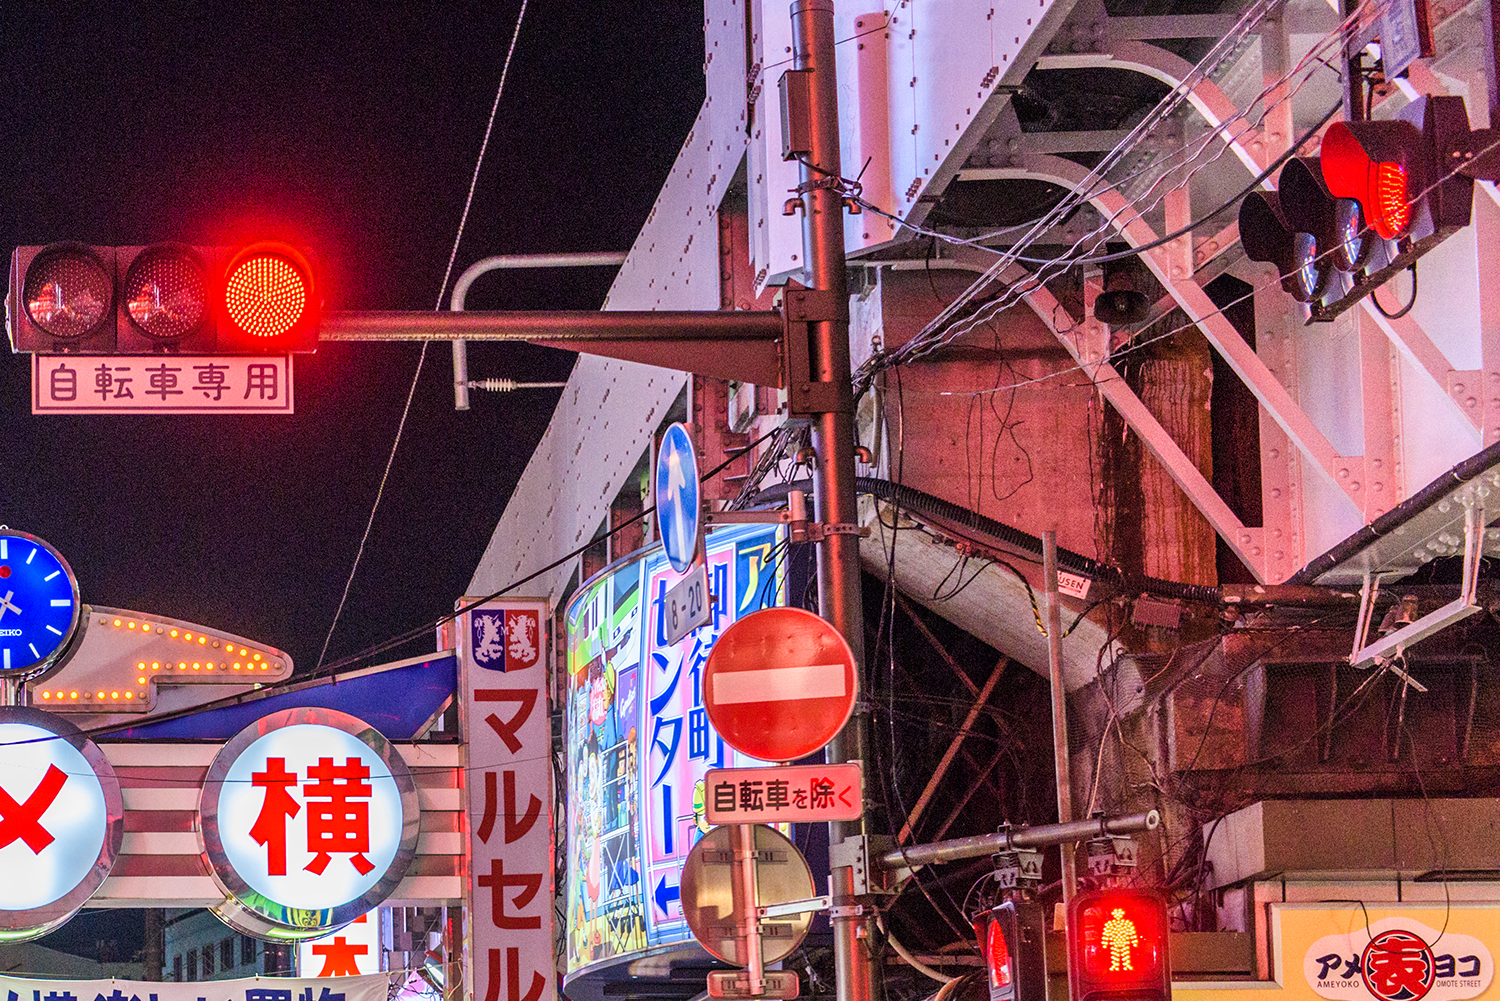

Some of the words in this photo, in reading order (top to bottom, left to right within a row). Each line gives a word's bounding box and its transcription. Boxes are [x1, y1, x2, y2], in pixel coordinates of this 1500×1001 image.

[50, 363, 279, 401] 自転車専用
[714, 777, 852, 813] 自転車を除く
[1317, 980, 1360, 988] AMEYOKO
[1436, 980, 1459, 988] OMOTE
[1460, 980, 1481, 988] STREET
